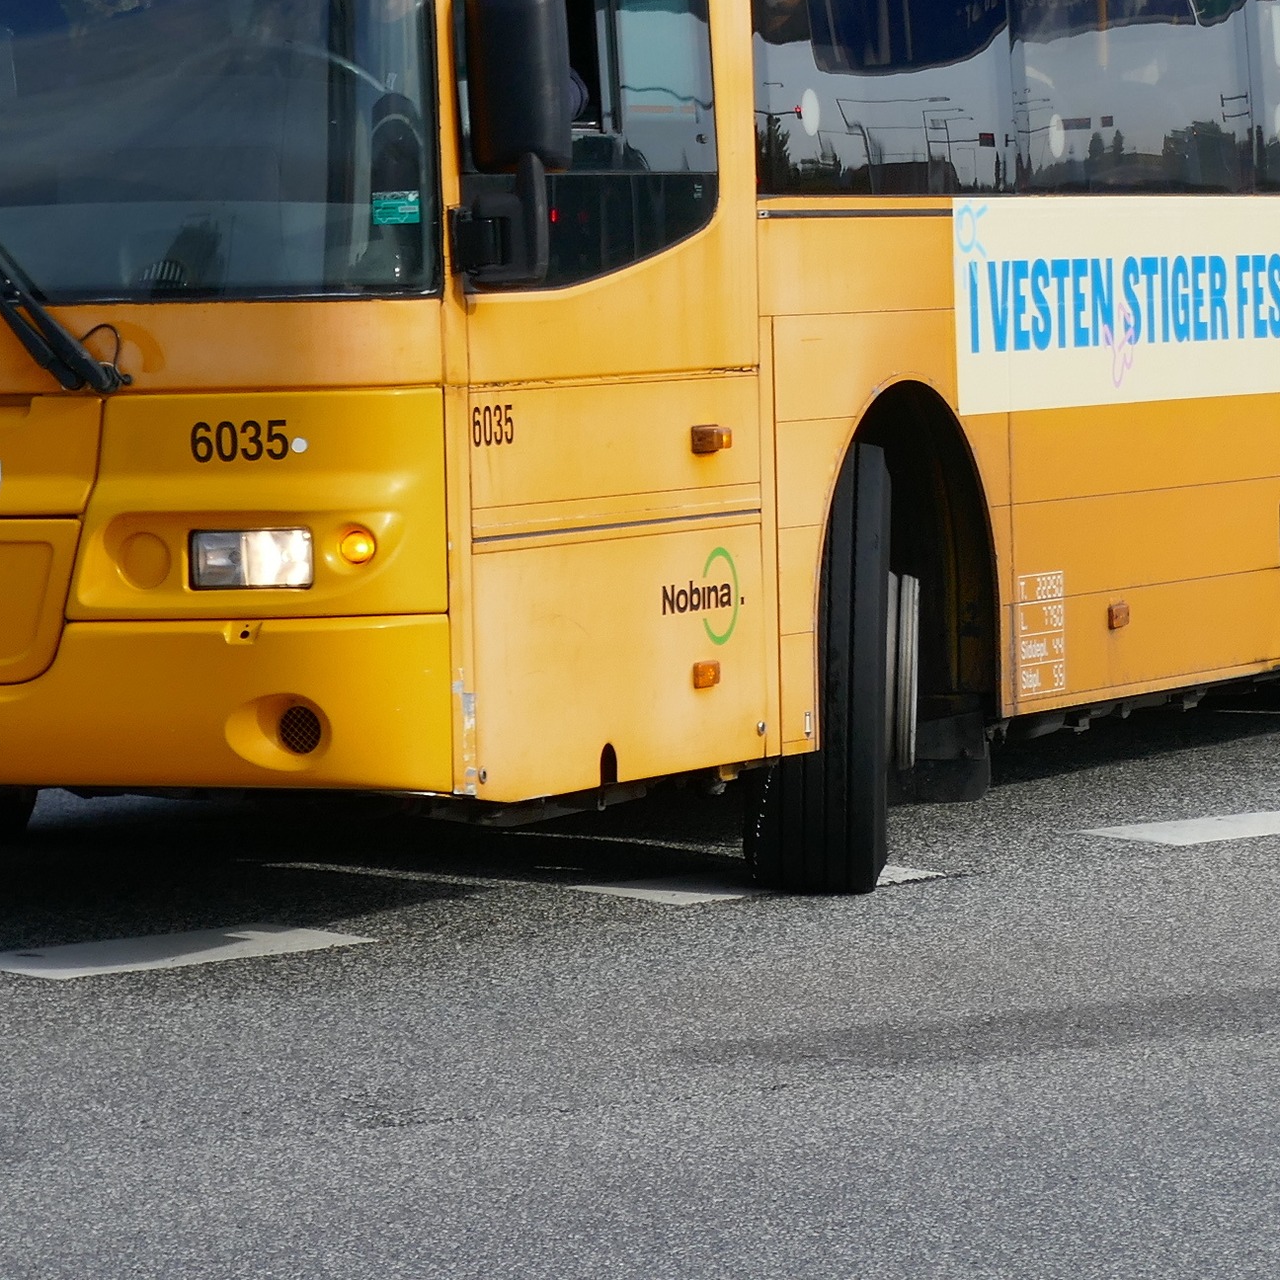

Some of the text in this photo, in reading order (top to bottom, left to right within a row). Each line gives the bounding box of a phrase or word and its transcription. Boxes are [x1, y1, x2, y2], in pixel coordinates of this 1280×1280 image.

[968, 261, 980, 354] I
[987, 257, 1115, 352] VESTEN
[1122, 255, 1228, 345] STIGER
[190, 419, 290, 463] 6035
[471, 404, 515, 447] 6035
